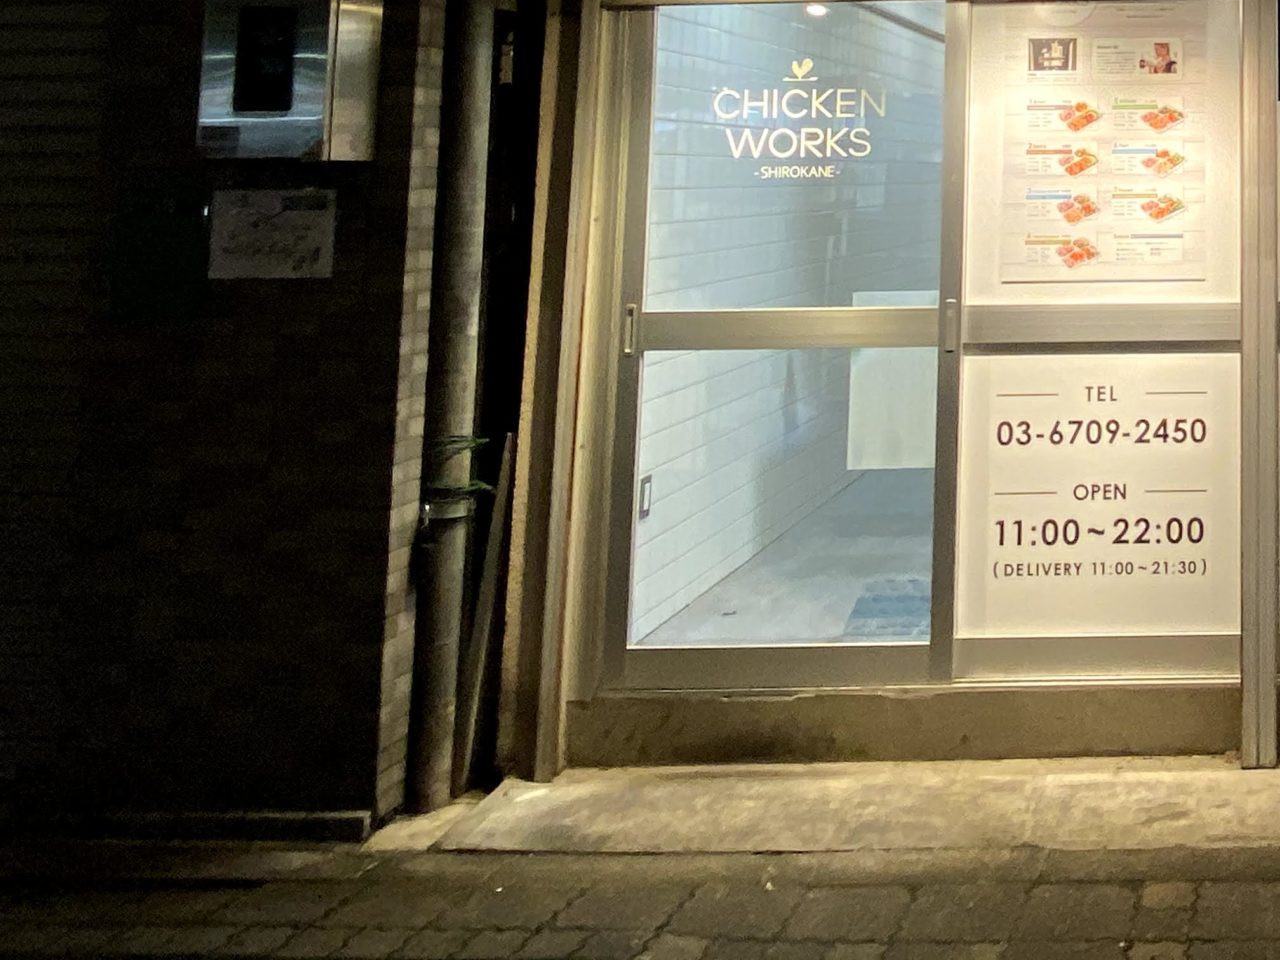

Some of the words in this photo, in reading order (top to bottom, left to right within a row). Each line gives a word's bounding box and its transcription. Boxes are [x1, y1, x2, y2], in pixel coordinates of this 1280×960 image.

[713, 87, 887, 119] CHICKEN
[725, 126, 873, 159] WORKS
[1084, 385, 1118, 403] TEL
[995, 418, 1208, 447] 03-6709-2450
[1072, 483, 1128, 501] OPEN
